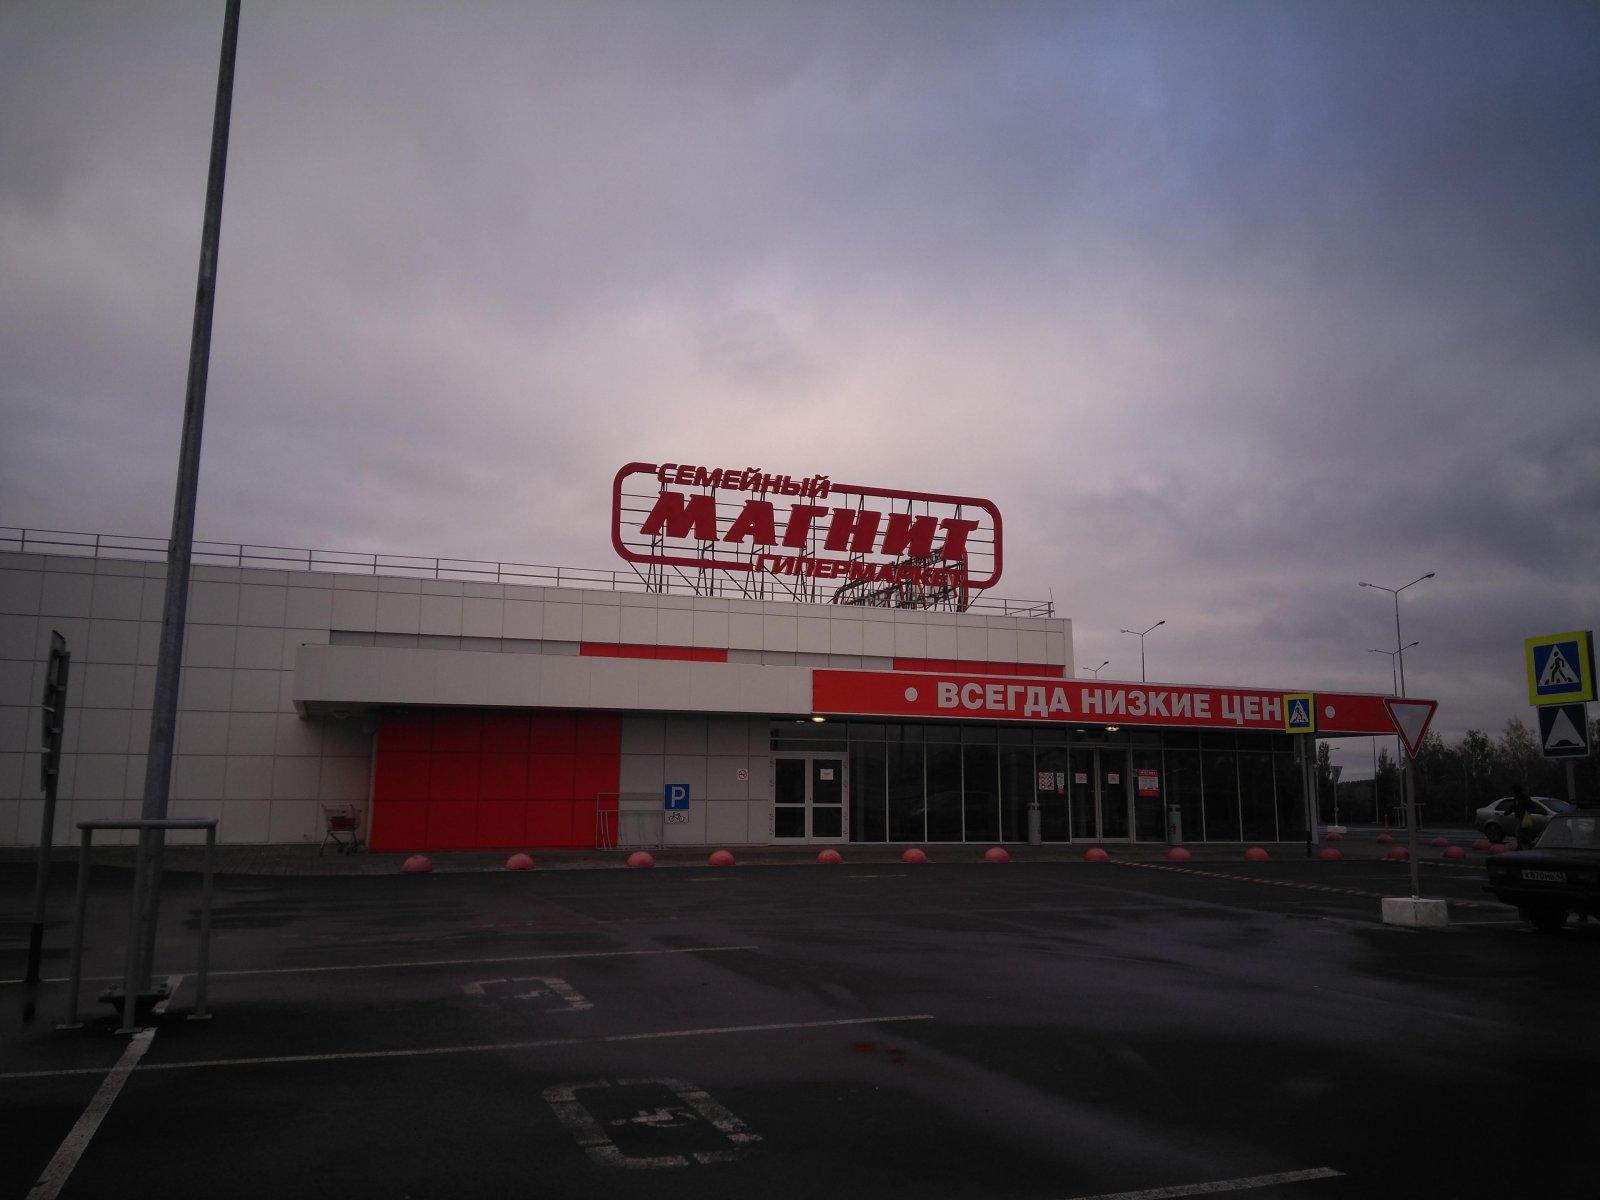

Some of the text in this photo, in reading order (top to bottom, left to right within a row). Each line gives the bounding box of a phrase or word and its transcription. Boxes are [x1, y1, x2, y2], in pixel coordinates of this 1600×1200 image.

[657, 463, 831, 499] СЕМЕЙНЫЙ
[639, 491, 980, 561] МАГНИТ
[754, 554, 966, 588] ГИПЕРМАРКЕТ
[937, 681, 1282, 724] ВСЕГДА НИЗКИЕ ЦЕН
